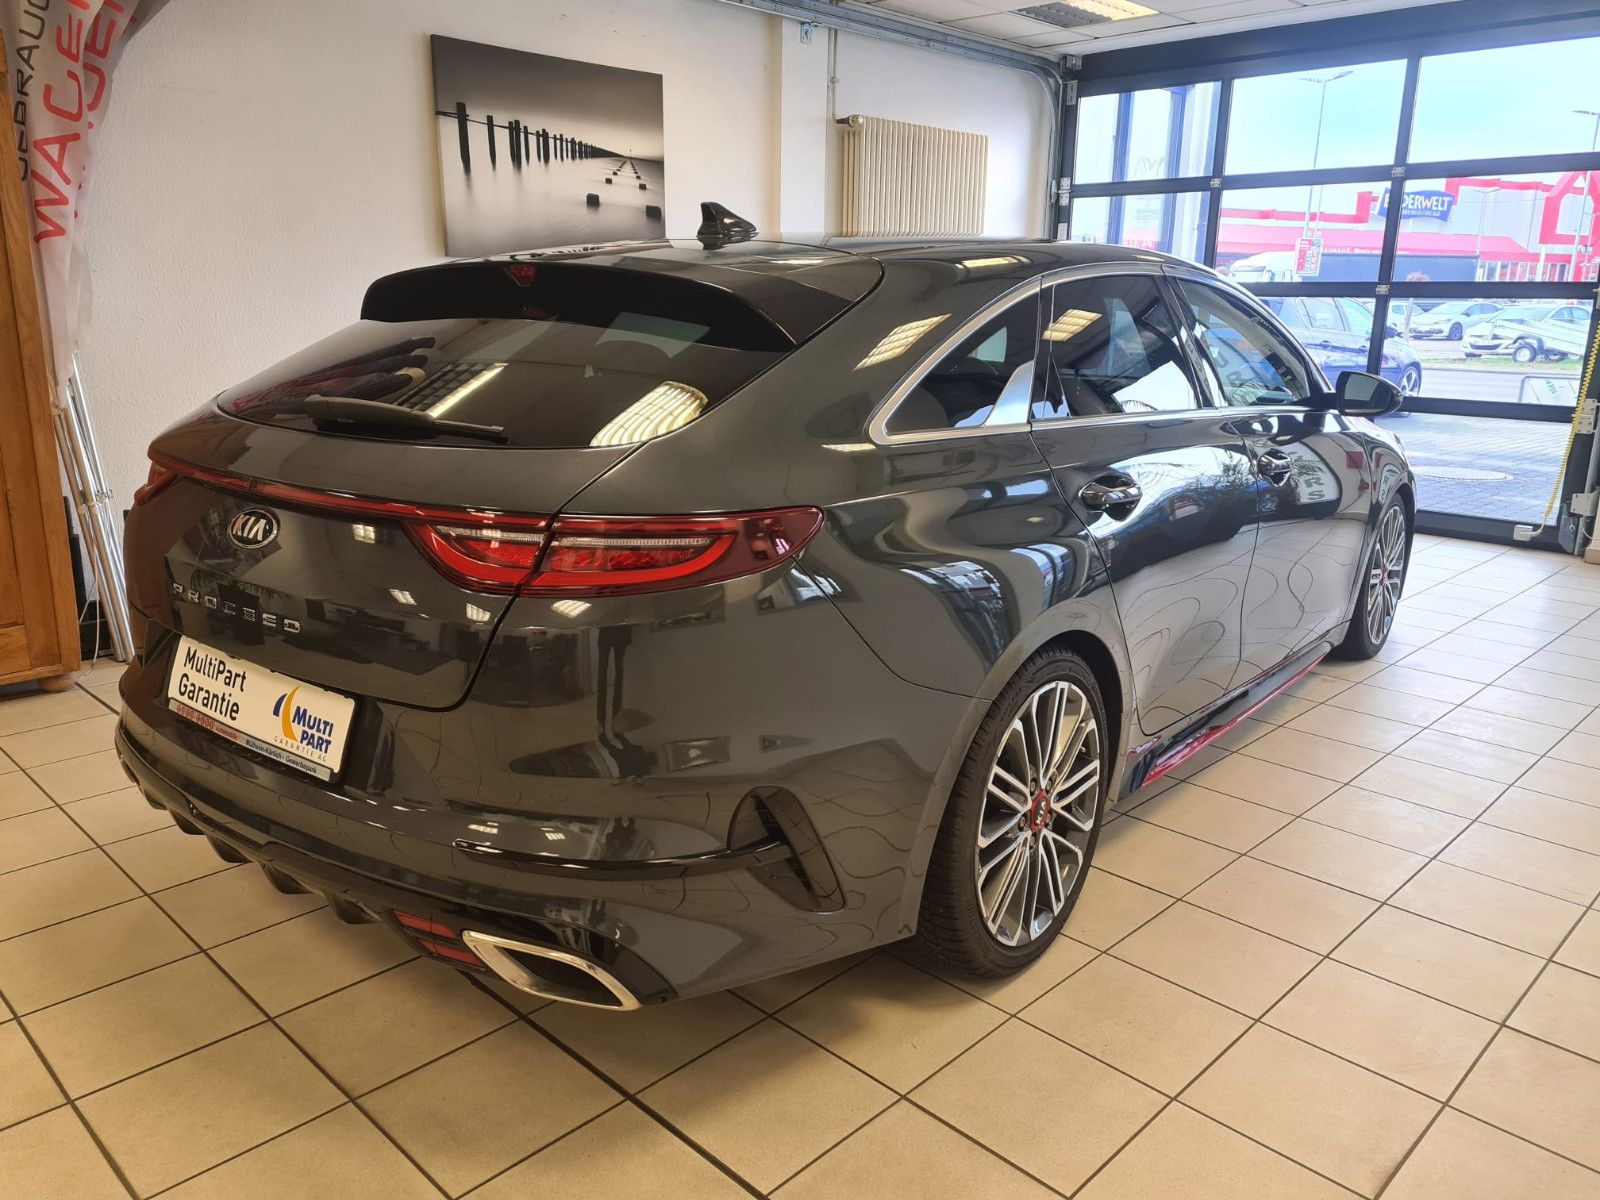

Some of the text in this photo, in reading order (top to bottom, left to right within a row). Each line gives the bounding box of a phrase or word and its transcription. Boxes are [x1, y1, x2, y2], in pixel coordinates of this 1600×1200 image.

[232, 514, 267, 541] KIA
[172, 582, 301, 634] PROCEED
[184, 646, 247, 693] MultiPart
[178, 672, 241, 722] Garantie
[291, 705, 335, 738] MULTI
[299, 729, 333, 755] PART
